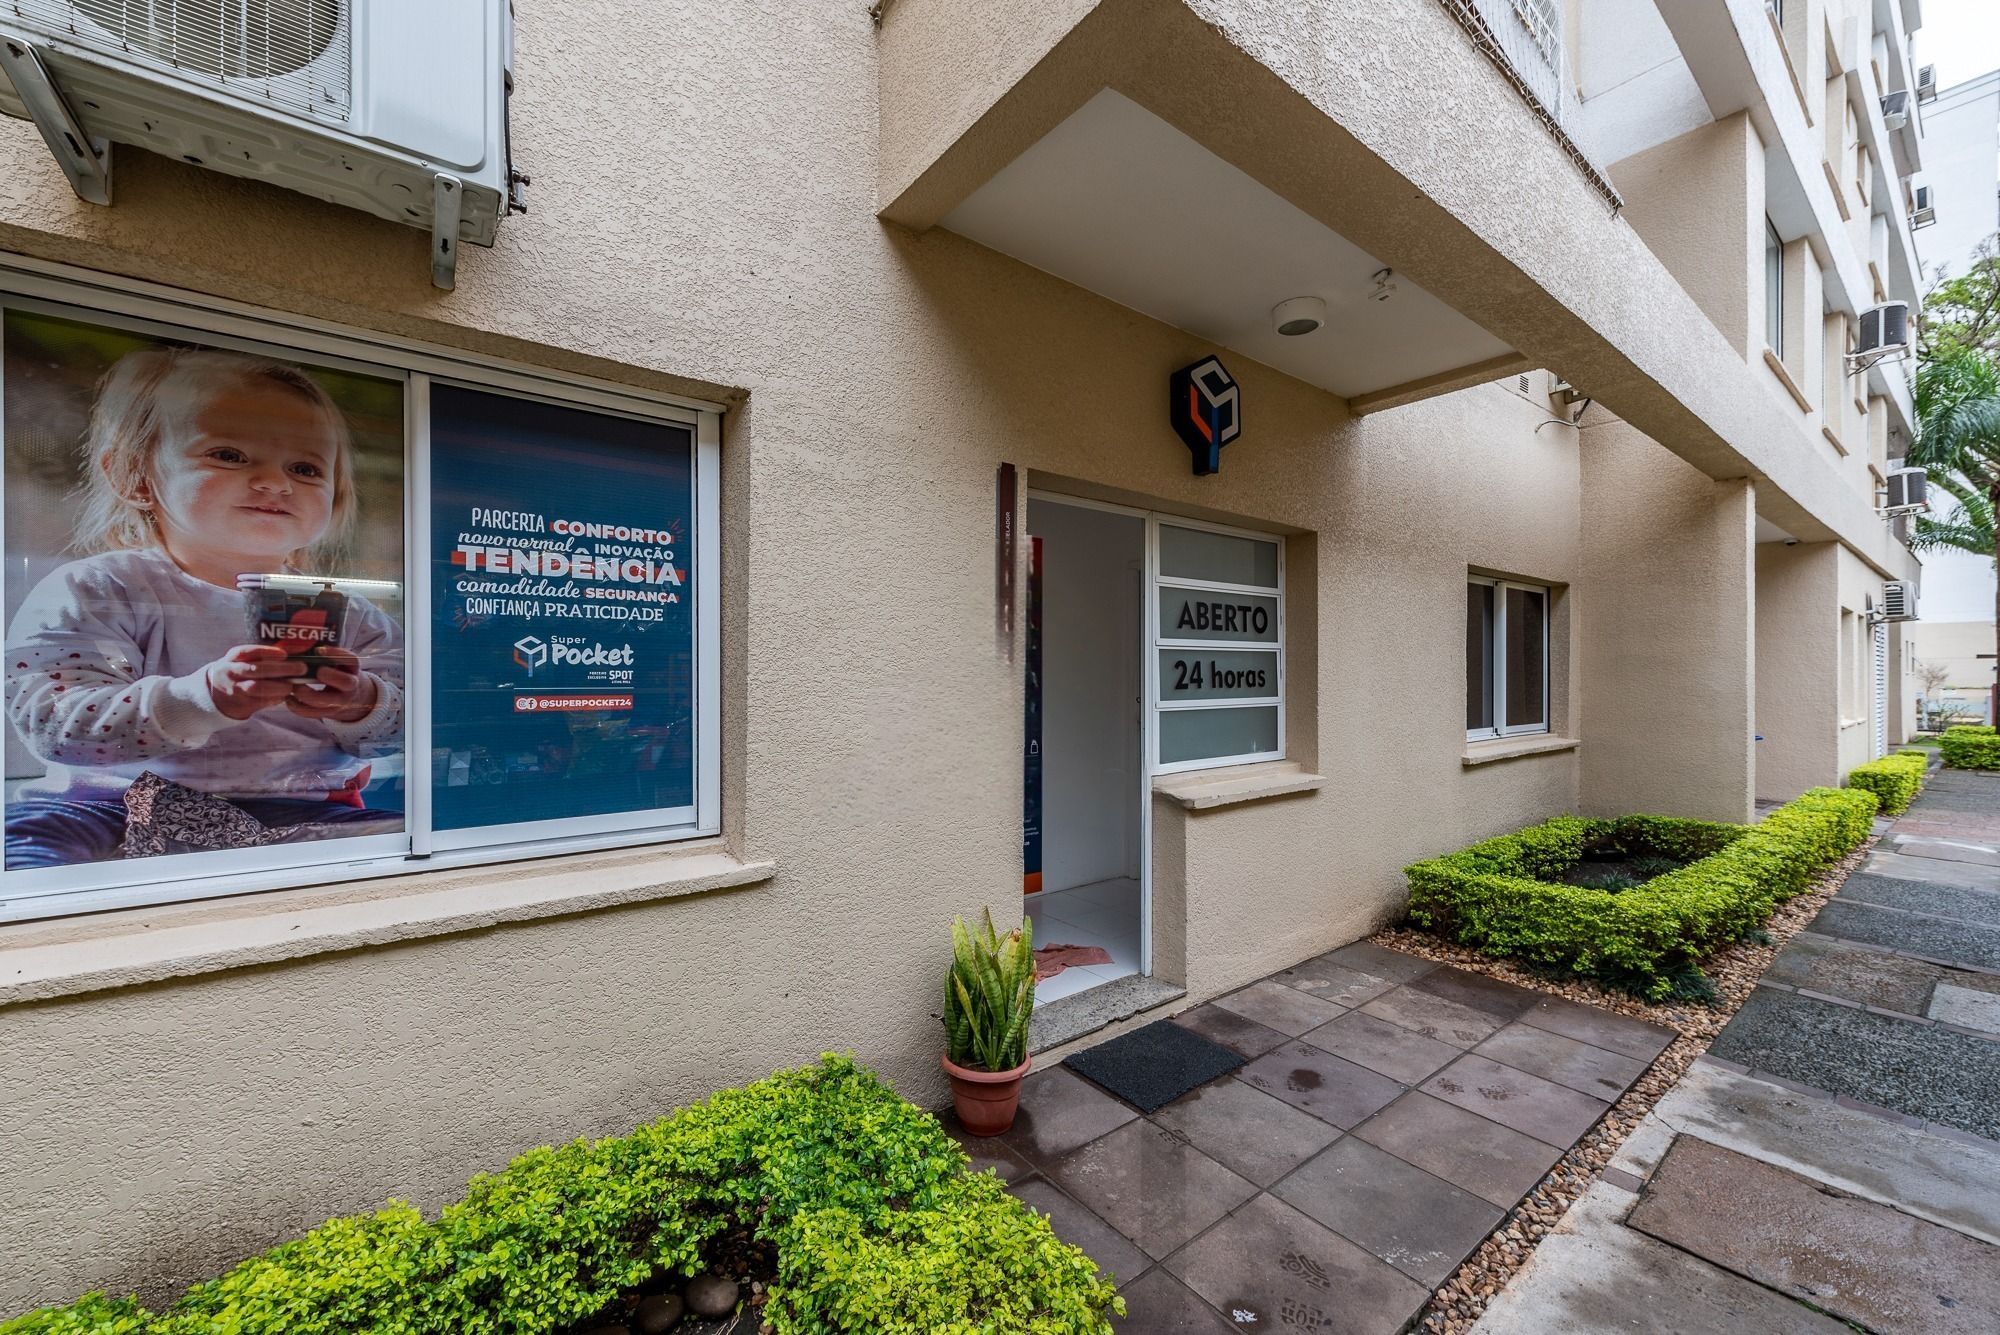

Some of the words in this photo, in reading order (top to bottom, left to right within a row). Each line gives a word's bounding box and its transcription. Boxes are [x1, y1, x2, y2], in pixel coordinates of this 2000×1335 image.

[471, 507, 545, 533] PARCERIA
[553, 519, 672, 545] CONFORTO
[458, 532, 504, 546] novo
[507, 537, 575, 552] normal
[594, 543, 674, 562] INOVAÇÃO
[457, 544, 682, 586] TENDÊNCIA
[456, 578, 581, 598] comodidade
[585, 587, 678, 605] SEGURANÇA
[466, 597, 540, 621] CONFIANÇA
[545, 602, 663, 622] PRATICIDADE
[1177, 600, 1268, 634] ABERTO
[551, 635, 586, 645] Super
[551, 642, 634, 666] Pocket
[609, 670, 634, 680] SPOT
[1174, 660, 1204, 690] 24
[1211, 660, 1266, 688] horas
[540, 698, 632, 708] @SUPERPOCKET24
